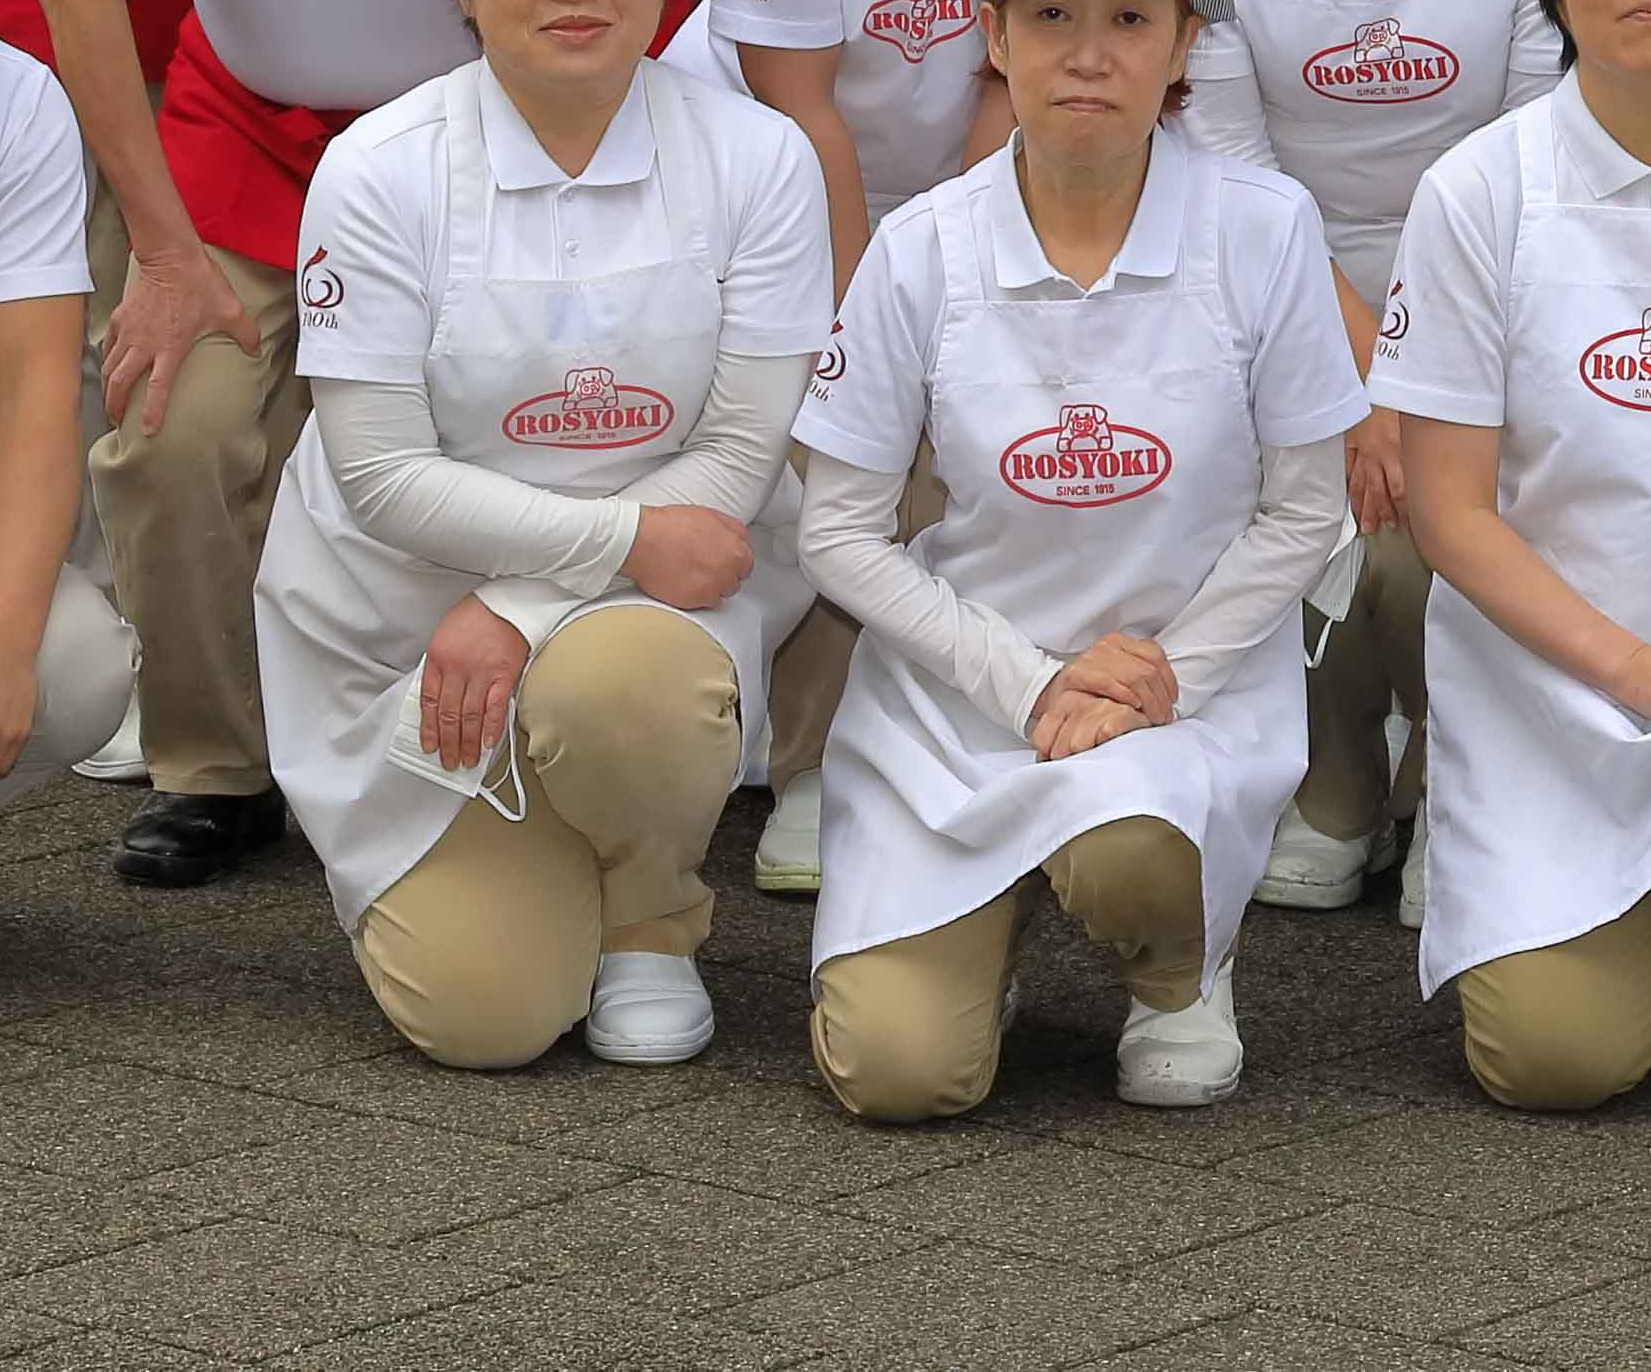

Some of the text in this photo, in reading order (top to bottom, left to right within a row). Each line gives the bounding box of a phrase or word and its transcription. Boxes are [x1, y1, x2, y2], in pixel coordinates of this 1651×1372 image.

[1313, 55, 1449, 86] ROSYOKI
[1356, 87, 1387, 97] SINCE
[515, 404, 663, 436] ROSYOKI
[1011, 447, 1159, 481] ROSYOKI
[1056, 483, 1115, 497] SINCE 1915
